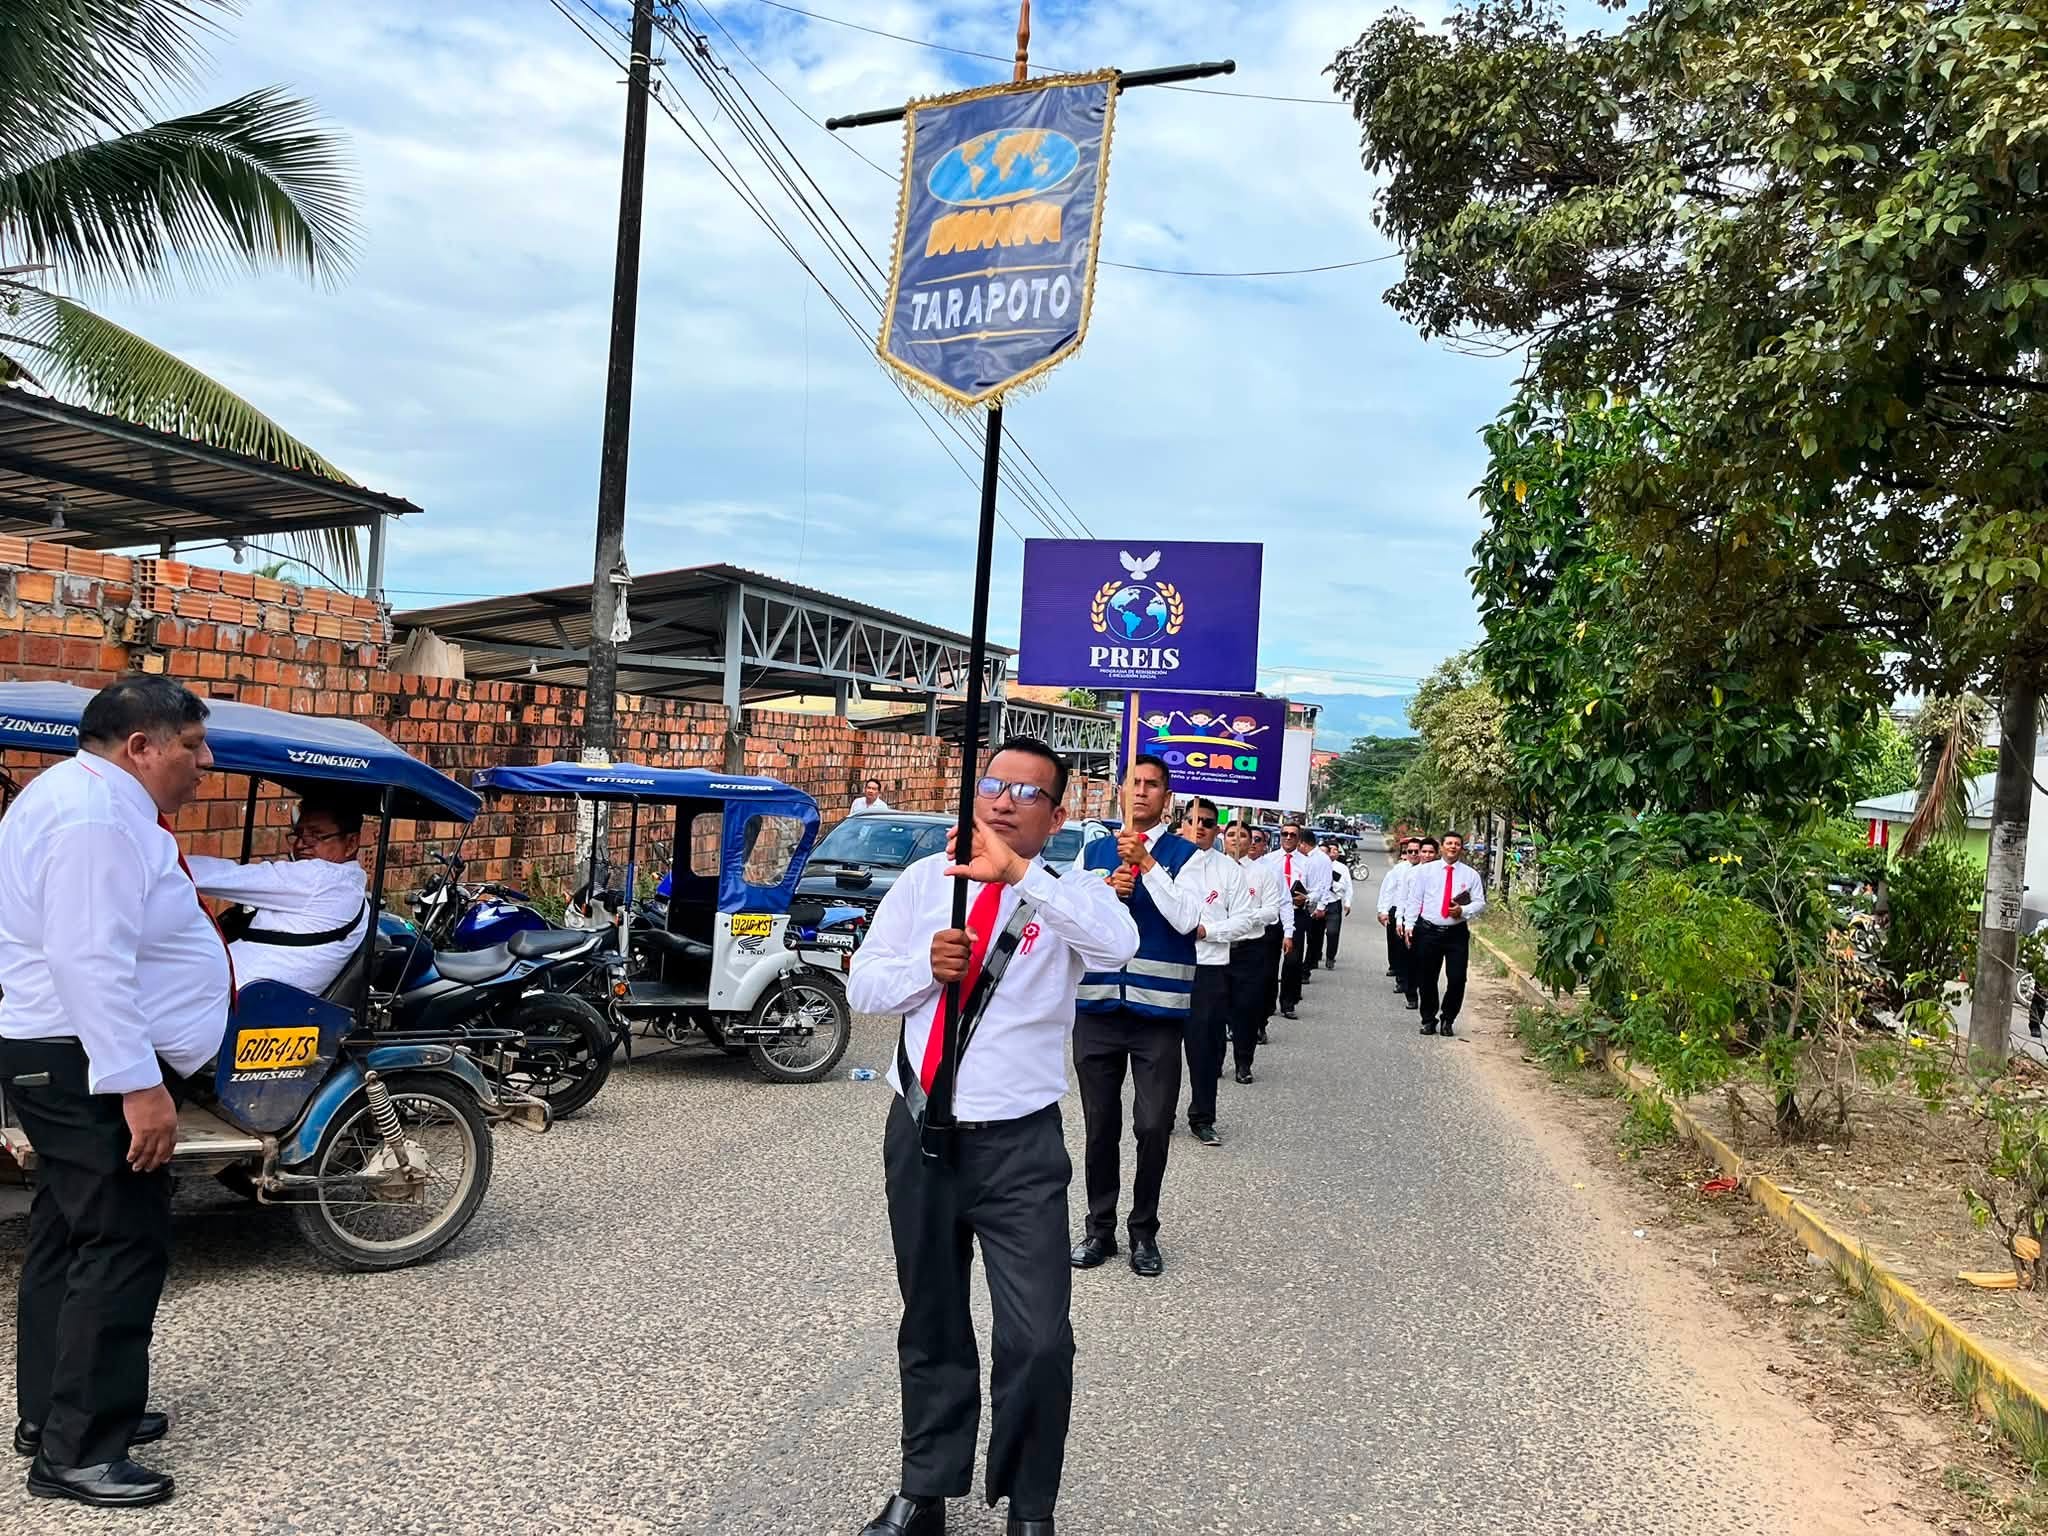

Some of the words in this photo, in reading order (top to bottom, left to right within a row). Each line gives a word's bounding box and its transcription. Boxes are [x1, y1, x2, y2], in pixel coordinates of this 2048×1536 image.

[911, 274, 1071, 331] TARAPOTO
[1089, 646, 1180, 670] PREIS
[3, 718, 80, 736] ZONGSHEN
[304, 752, 371, 769] ZONGSHEN
[586, 776, 656, 786] MOTOKAR
[709, 783, 775, 792] MOTOKAR
[230, 1069, 306, 1082] ZONGSHEN
